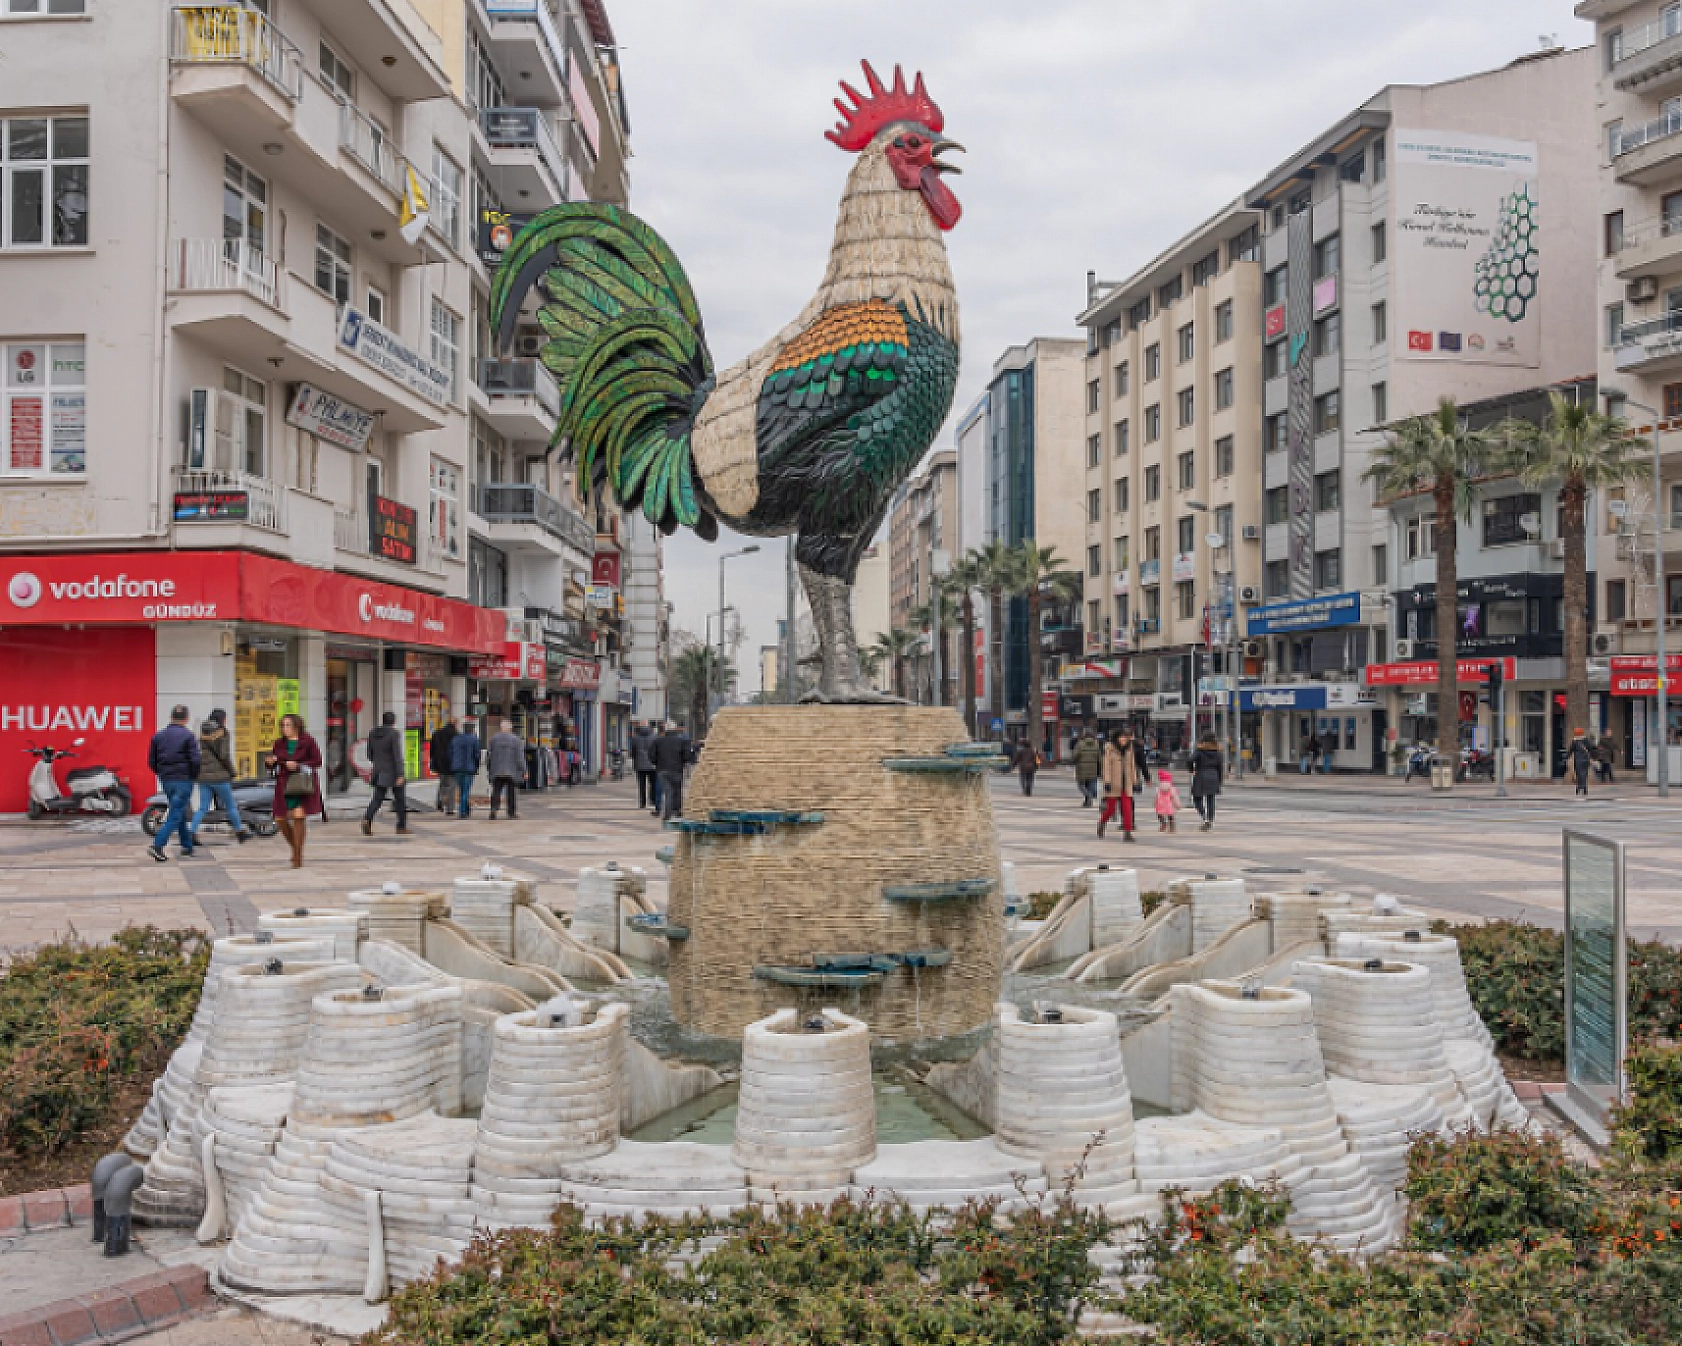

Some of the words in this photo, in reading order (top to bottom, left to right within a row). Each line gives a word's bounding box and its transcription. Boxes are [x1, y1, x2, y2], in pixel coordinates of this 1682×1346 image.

[49, 573, 176, 600] vodafone
[142, 602, 217, 619] GÜNDÜZ
[1, 704, 143, 731] HUAWEI
